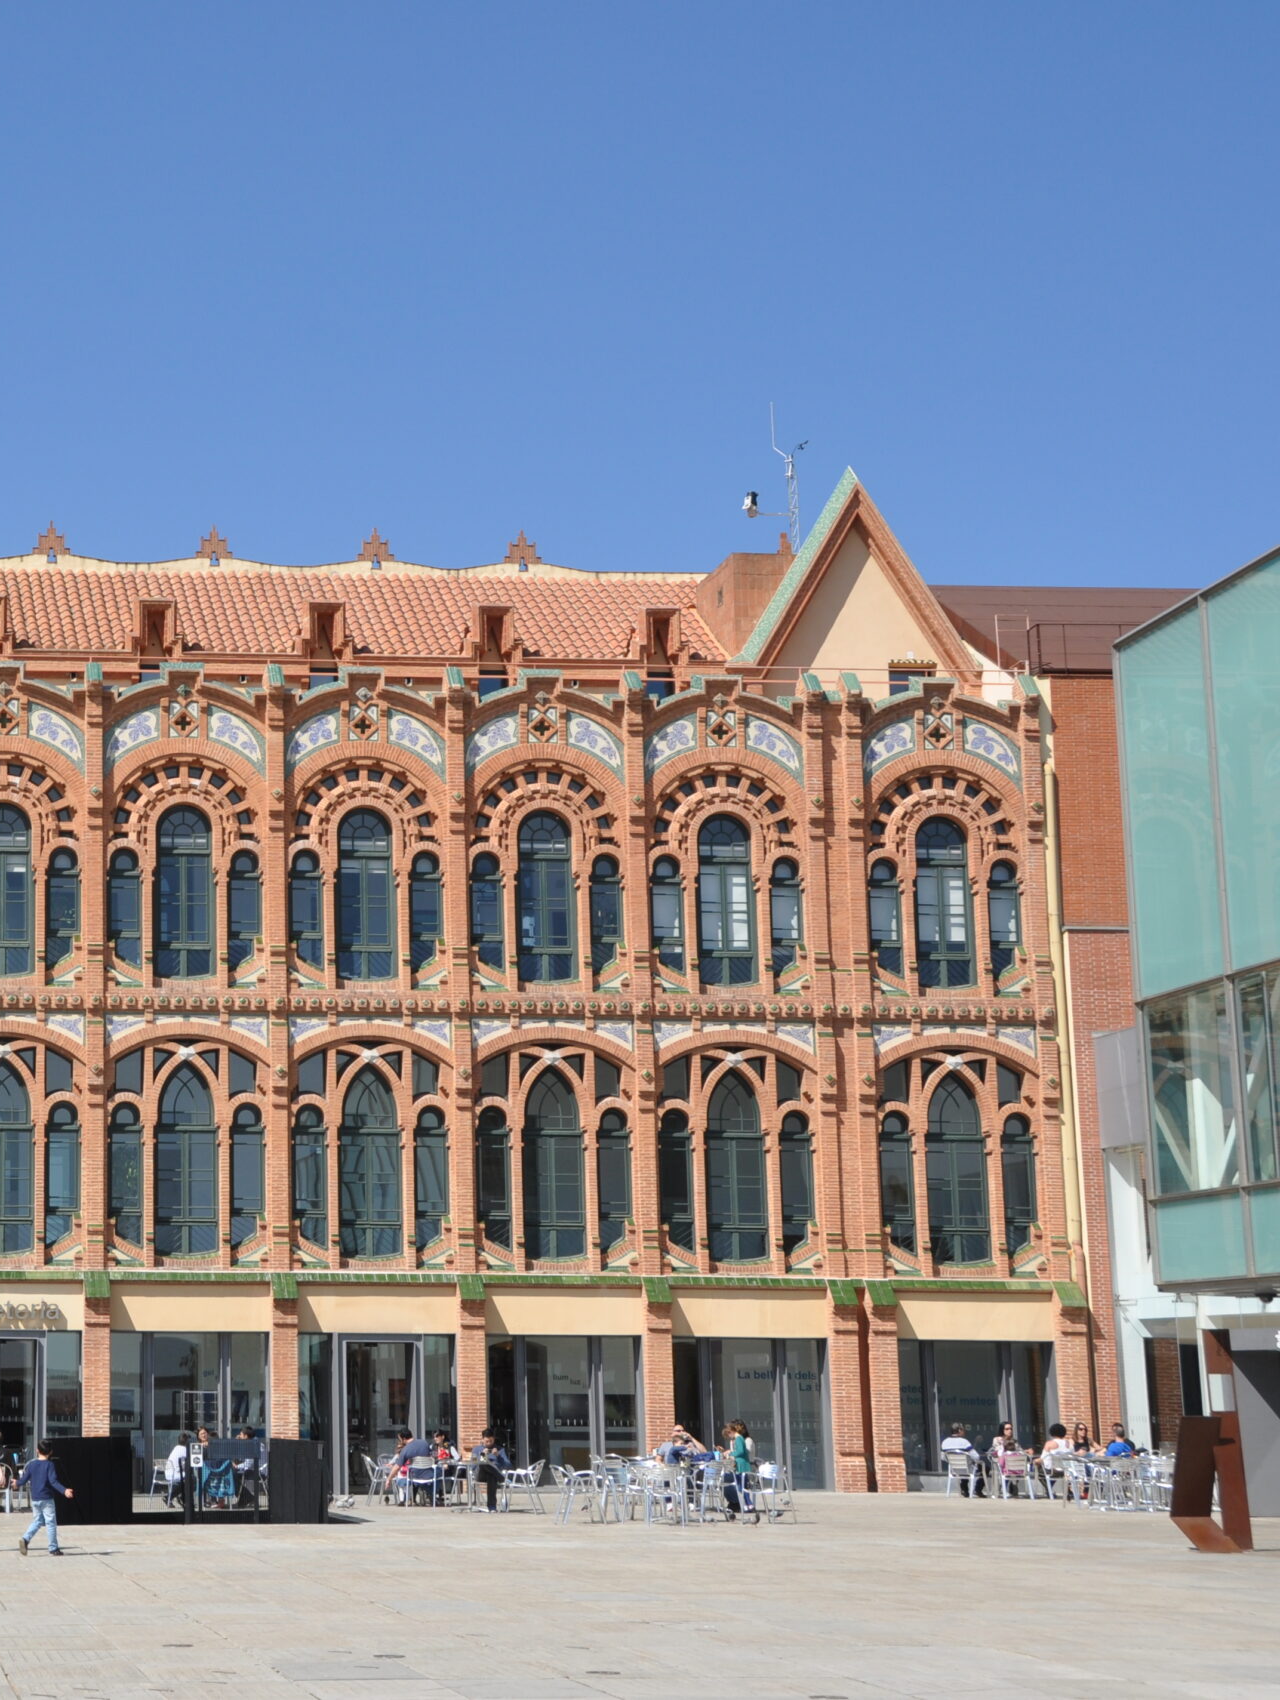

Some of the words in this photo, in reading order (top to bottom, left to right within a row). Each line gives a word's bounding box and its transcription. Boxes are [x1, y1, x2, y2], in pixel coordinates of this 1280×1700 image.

[737, 1370, 750, 1380] La
[794, 1370, 817, 1380] dels
[799, 1381, 812, 1392] La
